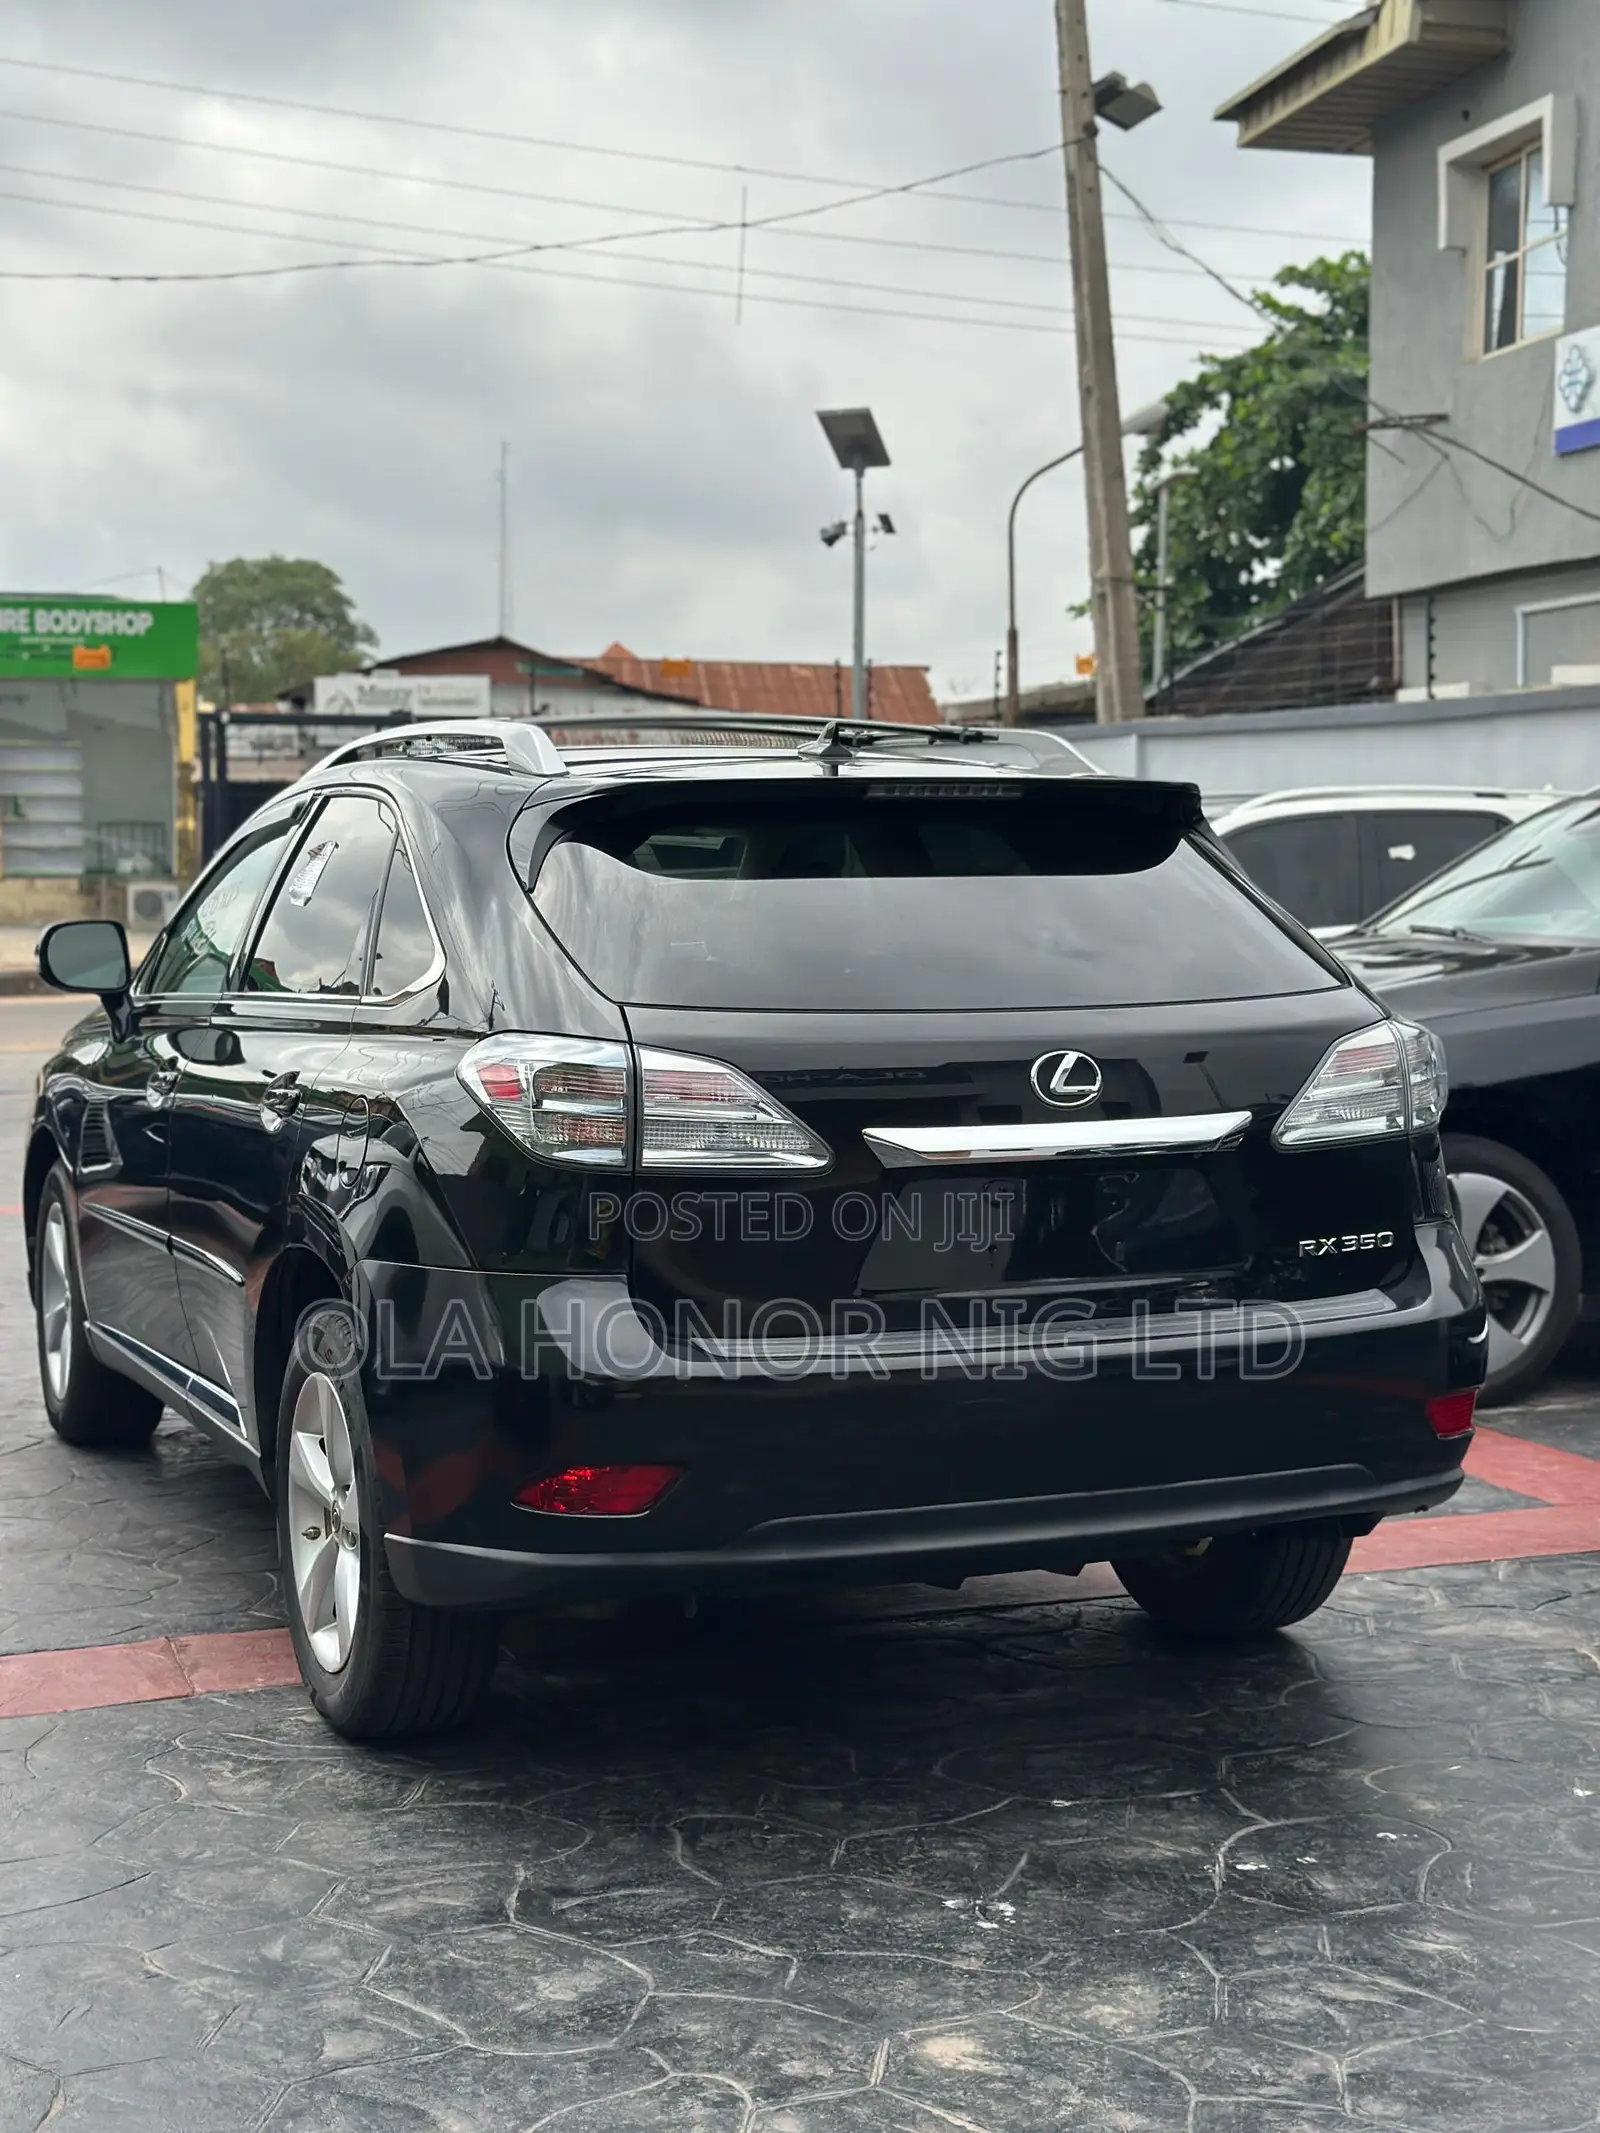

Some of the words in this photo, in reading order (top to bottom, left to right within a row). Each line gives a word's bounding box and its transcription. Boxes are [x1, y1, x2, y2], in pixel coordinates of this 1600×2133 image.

[34, 609, 154, 635] BODYSHOP
[1299, 1237, 1338, 1257] RX
[1341, 1231, 1394, 1252] 350
